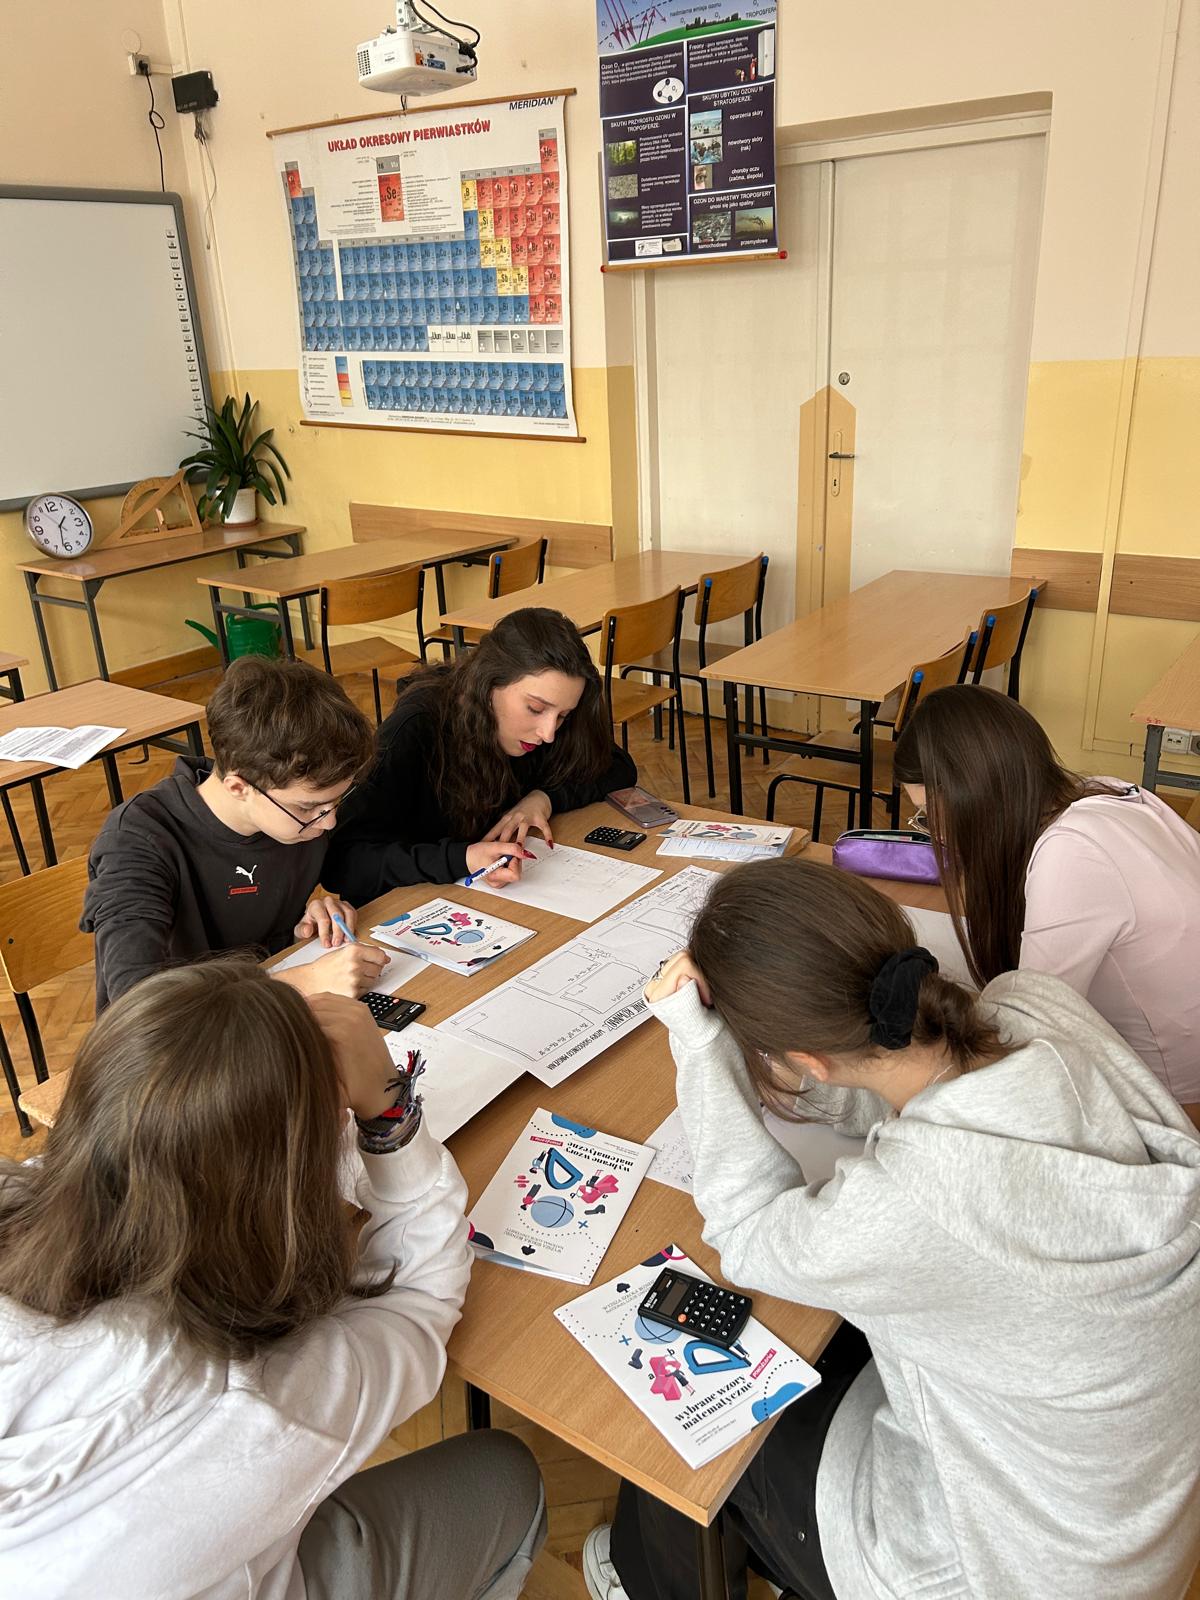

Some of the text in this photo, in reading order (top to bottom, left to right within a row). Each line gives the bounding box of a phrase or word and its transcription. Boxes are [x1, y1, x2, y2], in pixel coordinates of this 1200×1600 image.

[508, 98, 554, 111] MERIDIAN
[327, 119, 491, 153] UKŁAD OKRESOWY PIERWIASTKÓW
[386, 186, 397, 200] Se
[44, 501, 58, 513] 12
[73, 517, 84, 527] 3
[34, 525, 44, 536] 9
[64, 541, 73, 552] 6
[564, 1147, 591, 1161] wzory
[566, 1141, 635, 1168] matematyczne
[591, 1156, 632, 1174] wybrane
[569, 1191, 576, 1199] b
[666, 1347, 675, 1357] b
[647, 1371, 655, 1381] a
[674, 1374, 747, 1424] wybrane wzory
[681, 1380, 753, 1432] matematyczne
